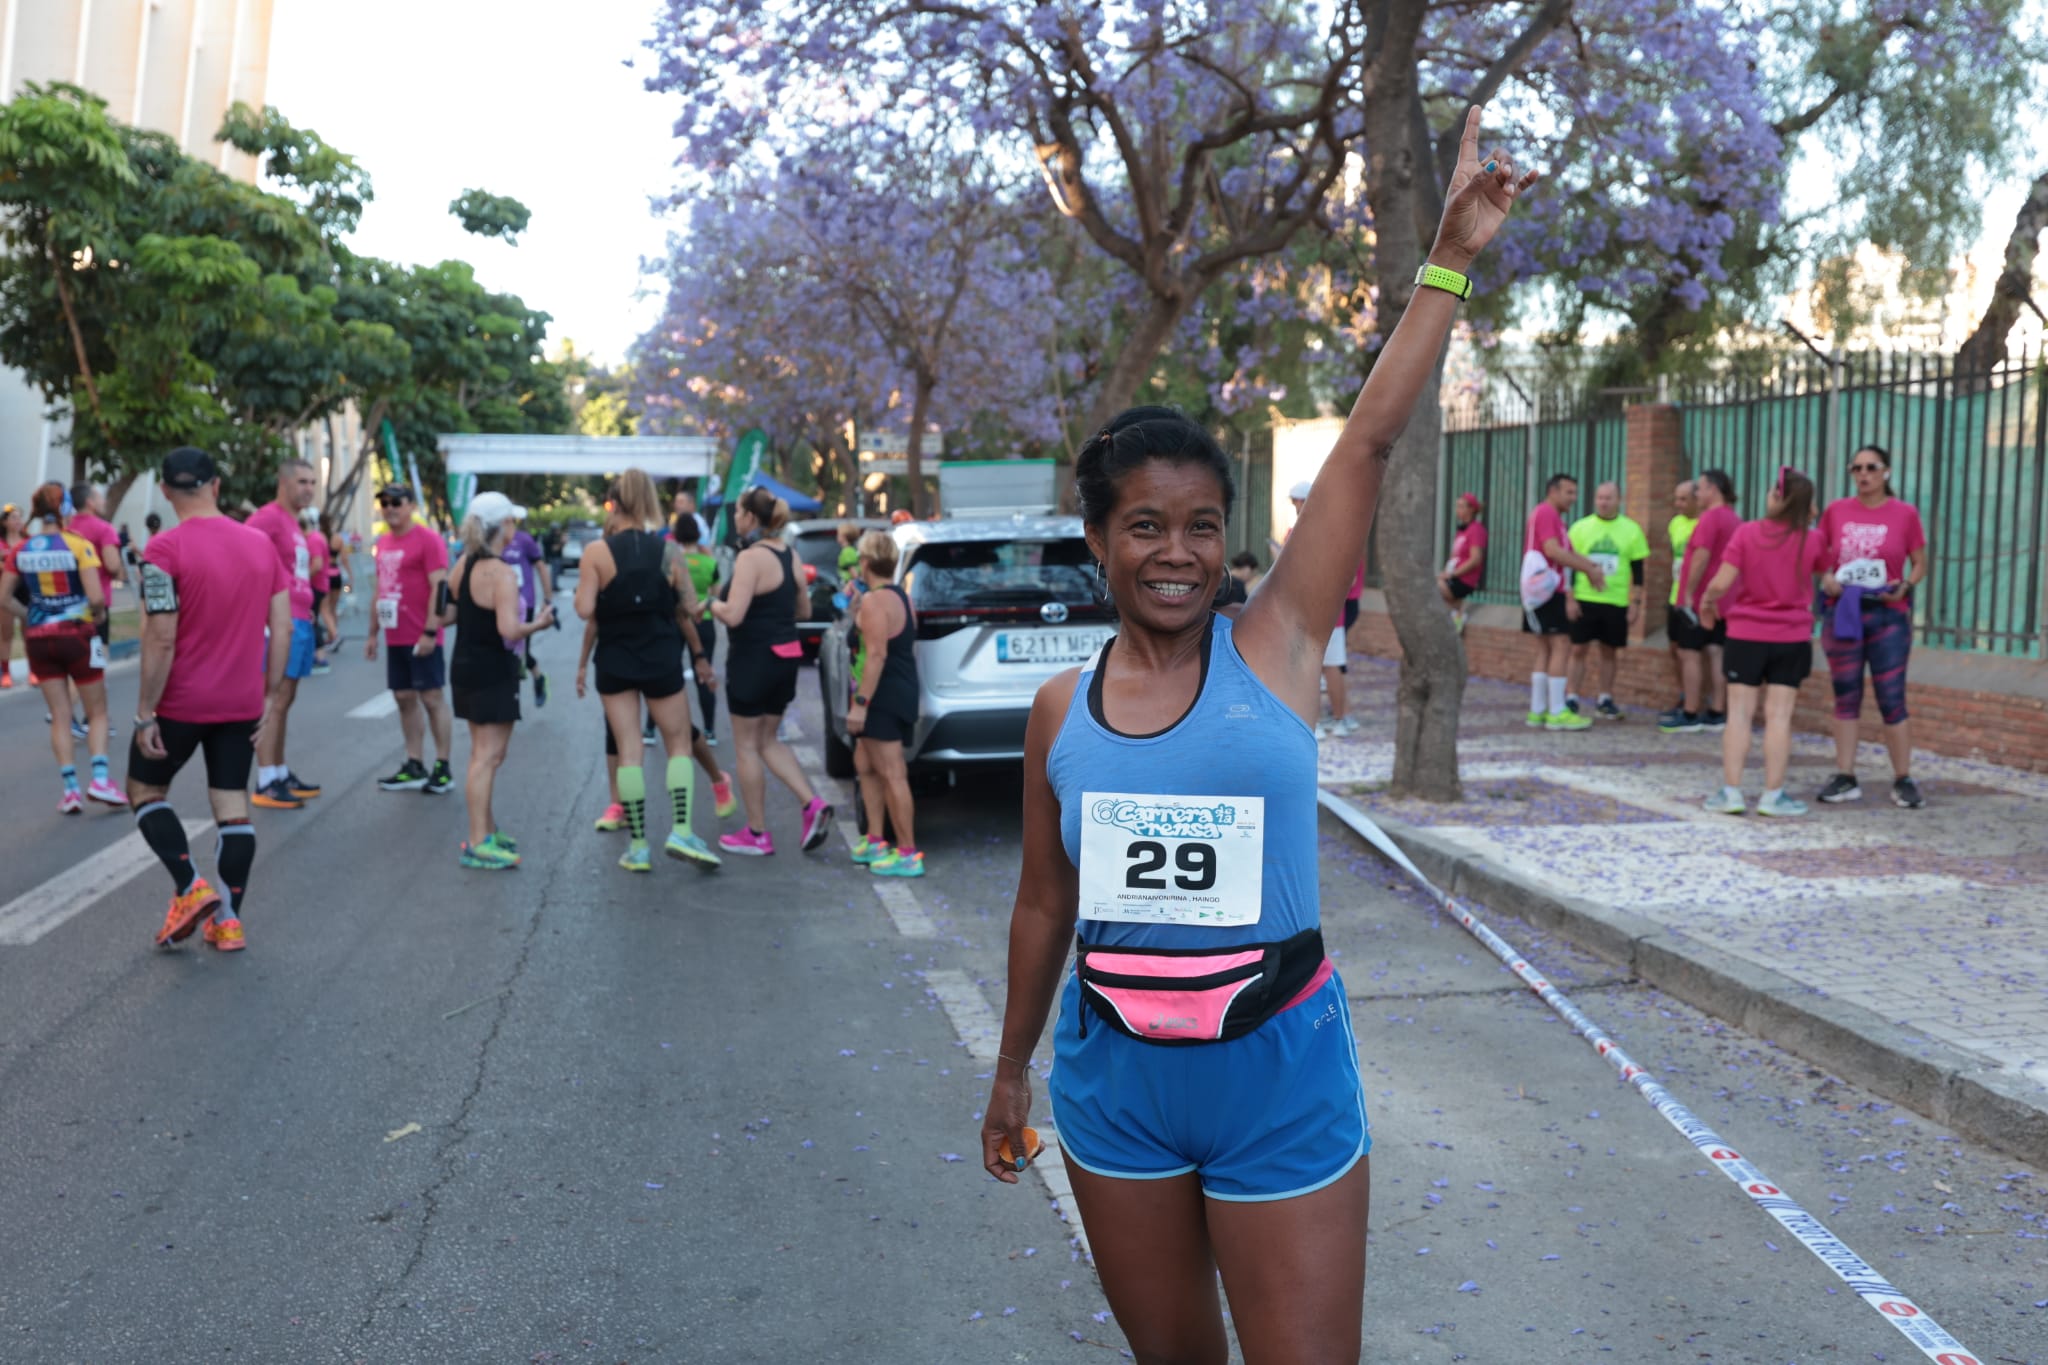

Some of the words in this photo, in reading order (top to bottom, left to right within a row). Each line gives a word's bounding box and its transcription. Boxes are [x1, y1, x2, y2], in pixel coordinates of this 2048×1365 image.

[1012, 635, 1059, 655] 6211
[1116, 801, 1214, 823] Carrera
[1126, 841, 1216, 890] 29
